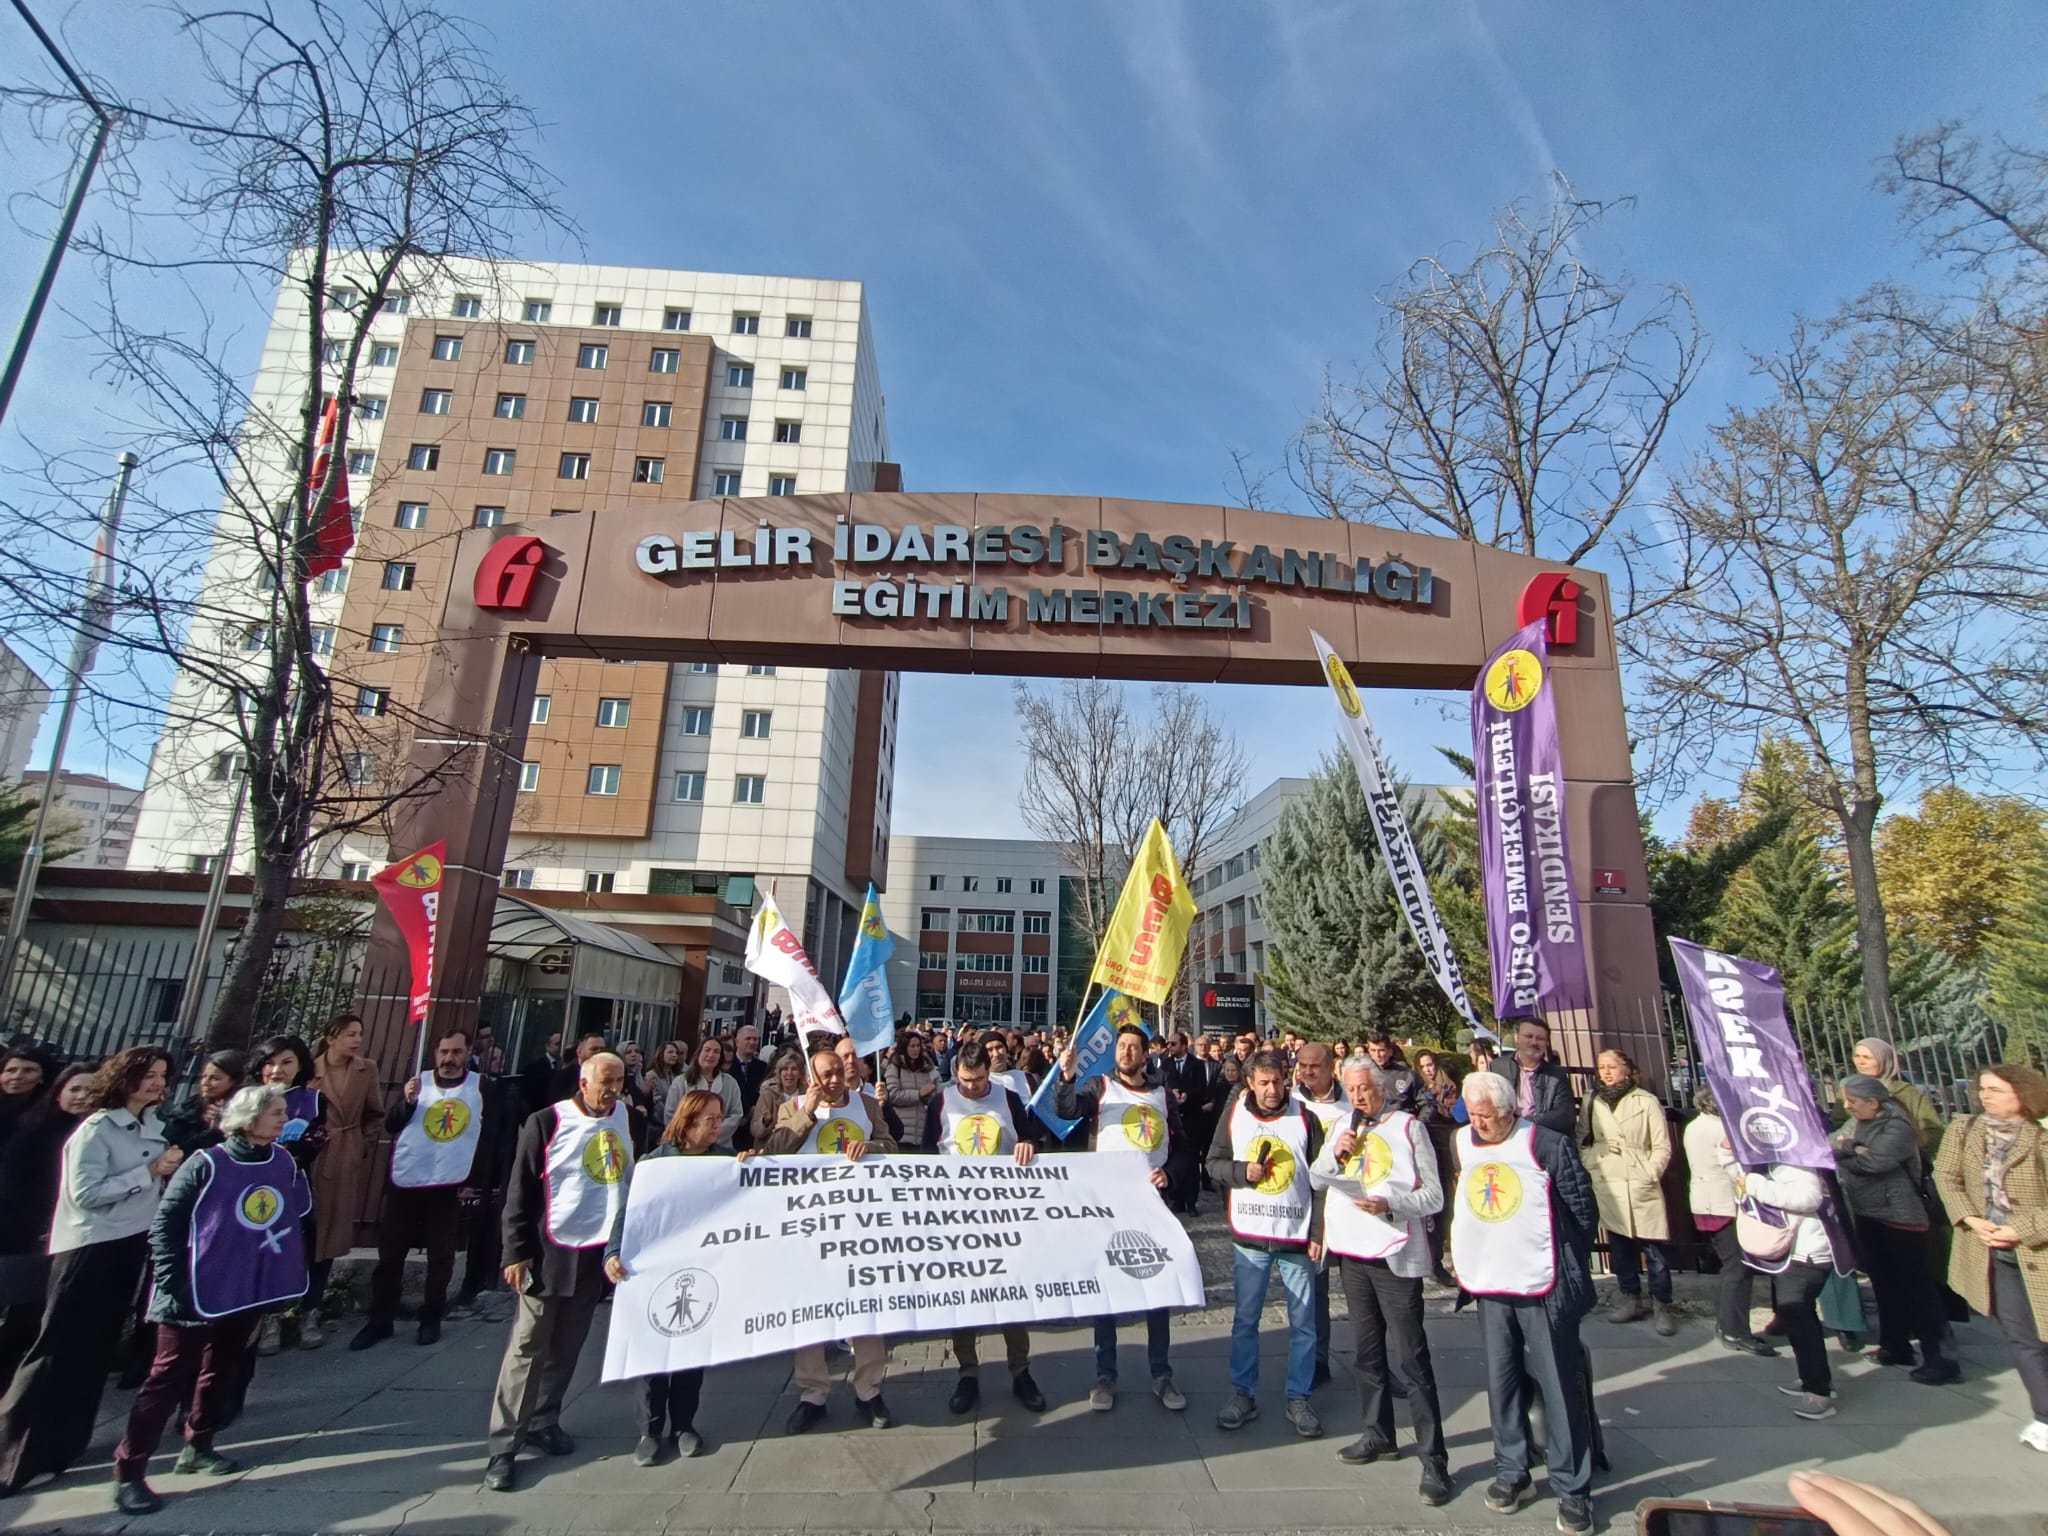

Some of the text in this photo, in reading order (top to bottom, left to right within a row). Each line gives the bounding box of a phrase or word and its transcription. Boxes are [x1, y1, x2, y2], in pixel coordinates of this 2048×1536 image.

[635, 513, 1433, 605] GELİR İDARESİ BAŞKANLIĞI
[831, 571, 1252, 630] EĞİTİM MERKEZİ
[1485, 718, 1529, 914] EMEKÇİLERİ
[1529, 771, 1577, 944] SENDİKASI
[1604, 872, 1613, 884] 7
[1129, 872, 1174, 966] BES
[1506, 921, 1540, 1010] BÜRO
[739, 1163, 1069, 1187] MERKEZ TAŞRA AYRIMINI
[787, 1184, 1046, 1212] KABUL ETMİYORUZ
[700, 1205, 1116, 1248] ADİL EŞİT VE HAKKIMIZ OLAN
[820, 1231, 1023, 1260] PROMOSYONU
[847, 1258, 1008, 1288] İSTİYORUZ
[1104, 1247, 1175, 1267] KESK
[744, 1275, 1102, 1335] BÜRO EMEKÇİLERİ SENDİKASI ANKARA ŞUBELERİ
